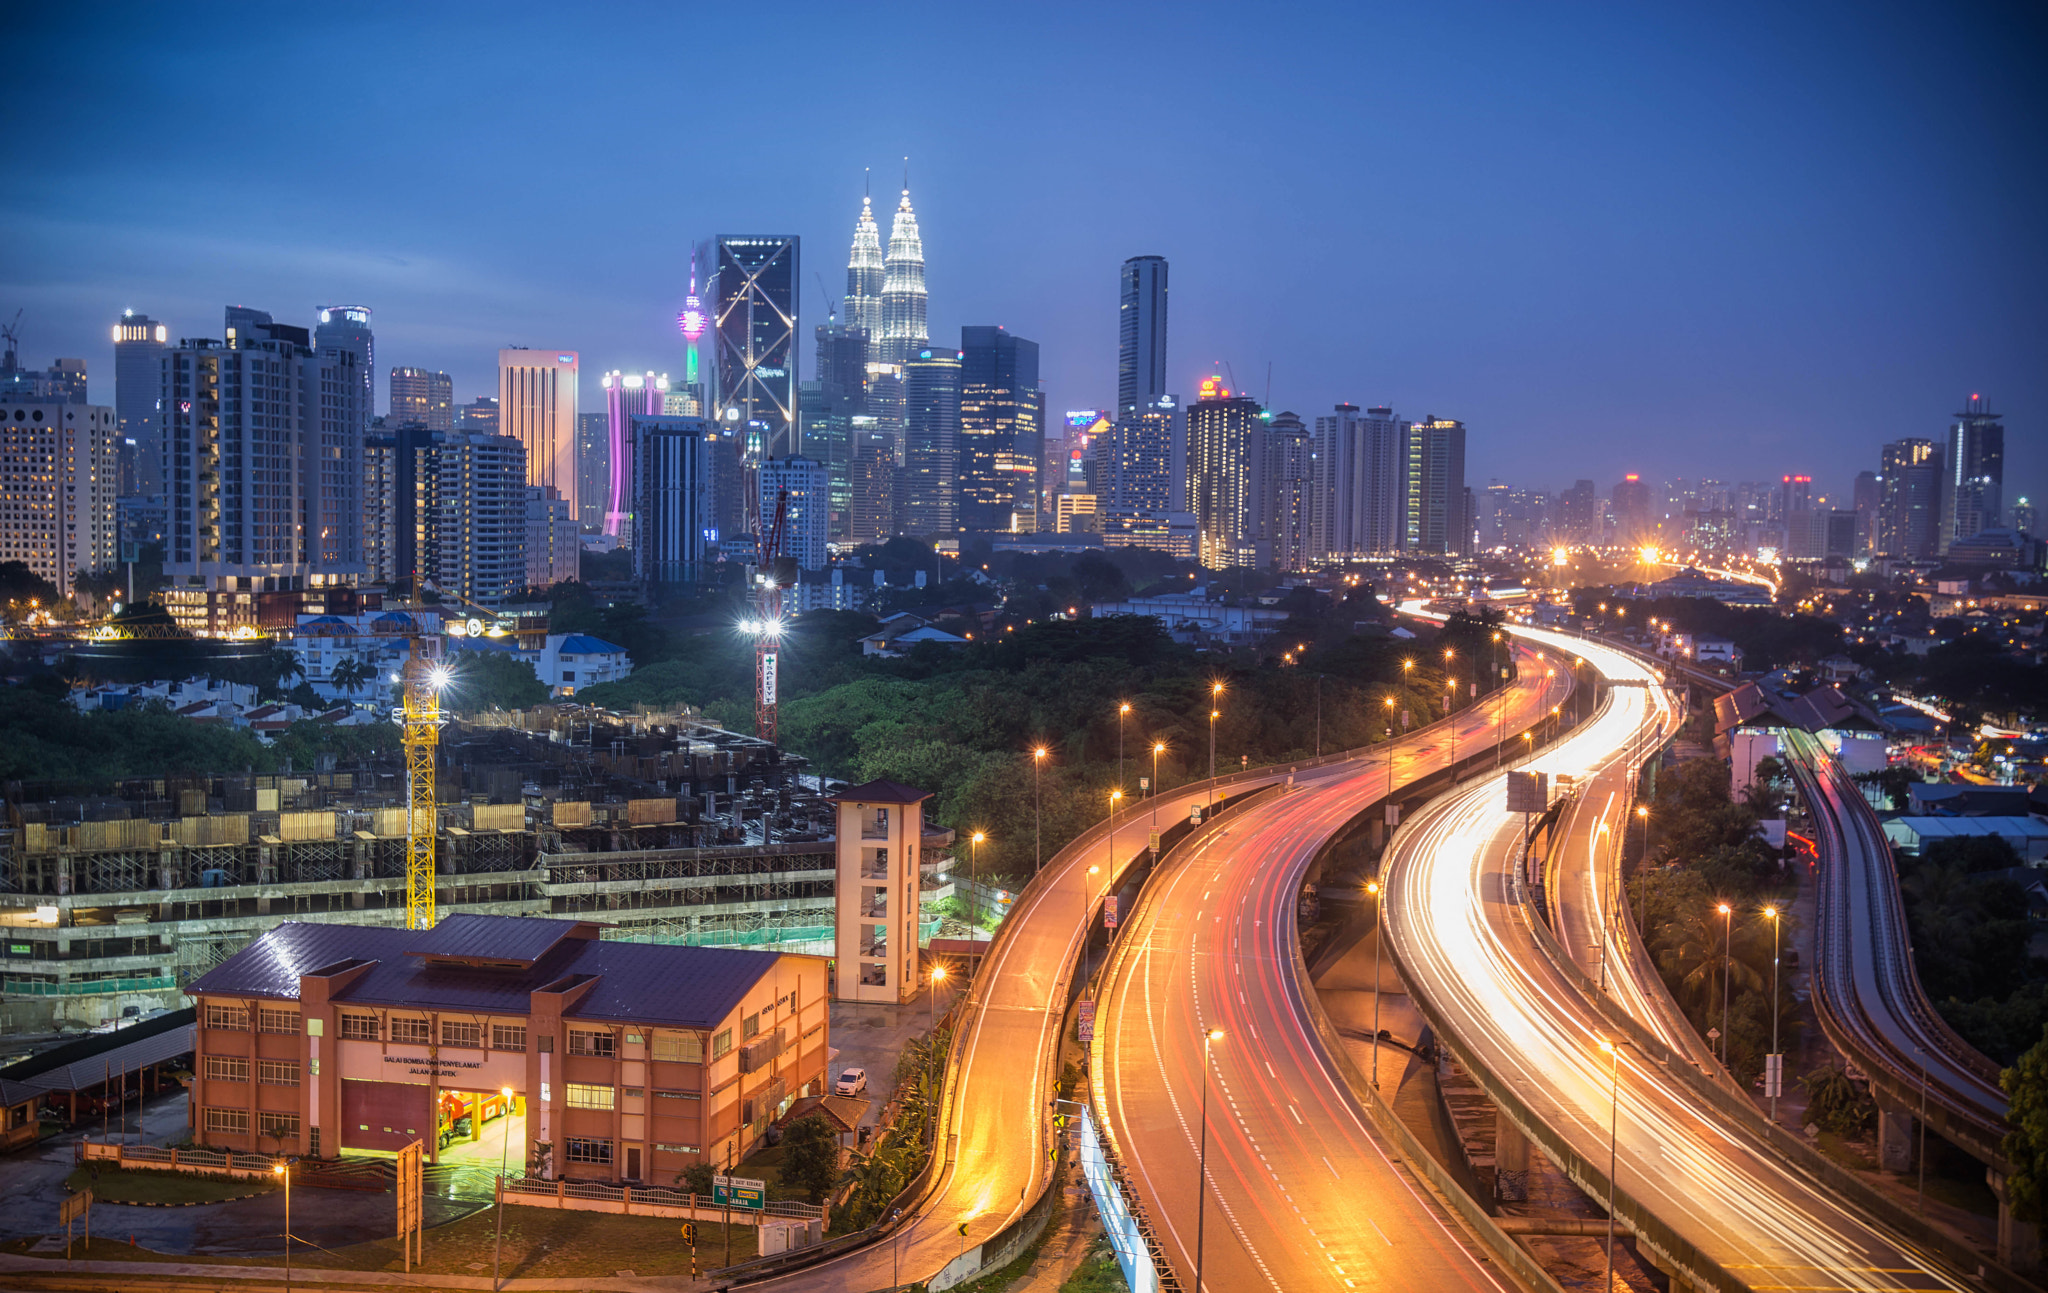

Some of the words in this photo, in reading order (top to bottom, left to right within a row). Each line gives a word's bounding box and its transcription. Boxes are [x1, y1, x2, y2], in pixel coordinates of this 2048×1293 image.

[384, 1056, 402, 1064] BALAI
[426, 1059, 438, 1067] DAN
[439, 1060, 480, 1069] PENYELAMAT
[430, 1069, 457, 1077] JELATEK
